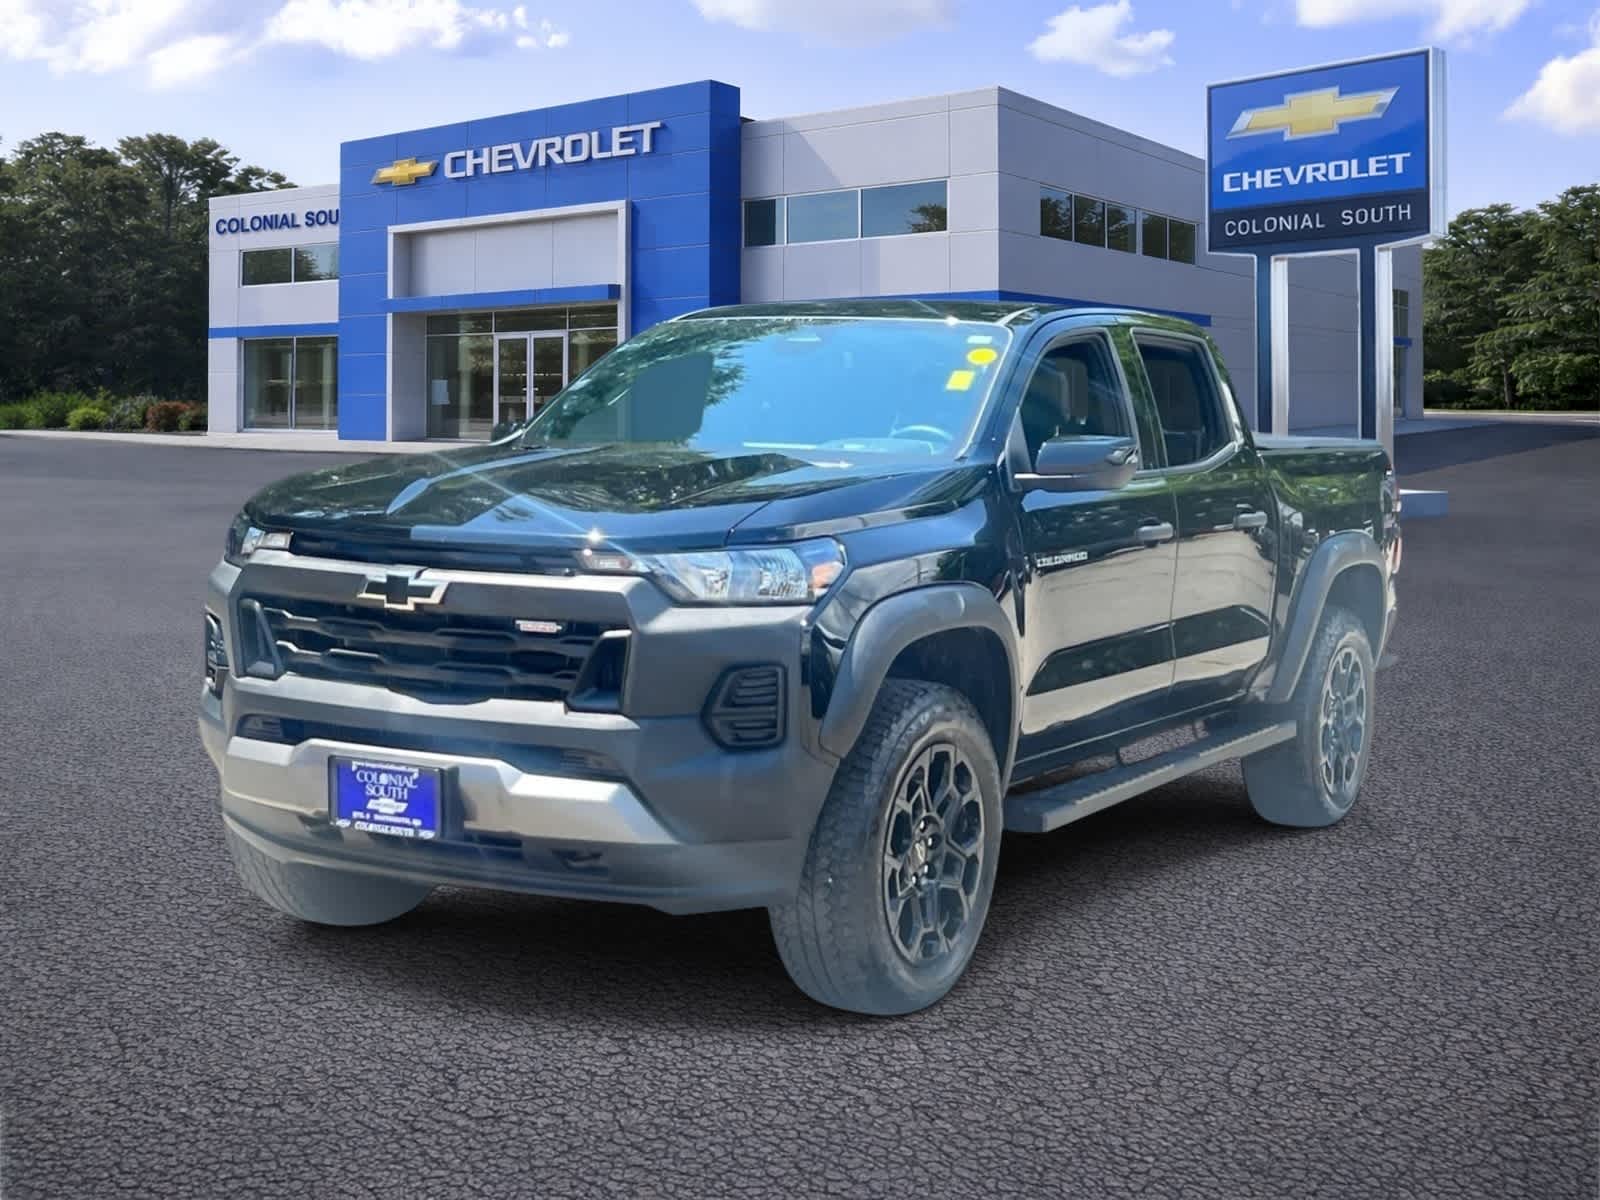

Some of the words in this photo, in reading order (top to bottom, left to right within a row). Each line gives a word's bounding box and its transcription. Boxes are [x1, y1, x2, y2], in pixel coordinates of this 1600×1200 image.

[443, 121, 663, 180] CHEVROLET
[1223, 152, 1411, 193] CHEVROLET
[216, 212, 300, 235] COLONIAL
[1224, 213, 1326, 237] COLONIAL
[1341, 203, 1412, 227] SOUTH
[356, 769, 418, 789] COLONIAL
[365, 784, 408, 801] SOUTH
